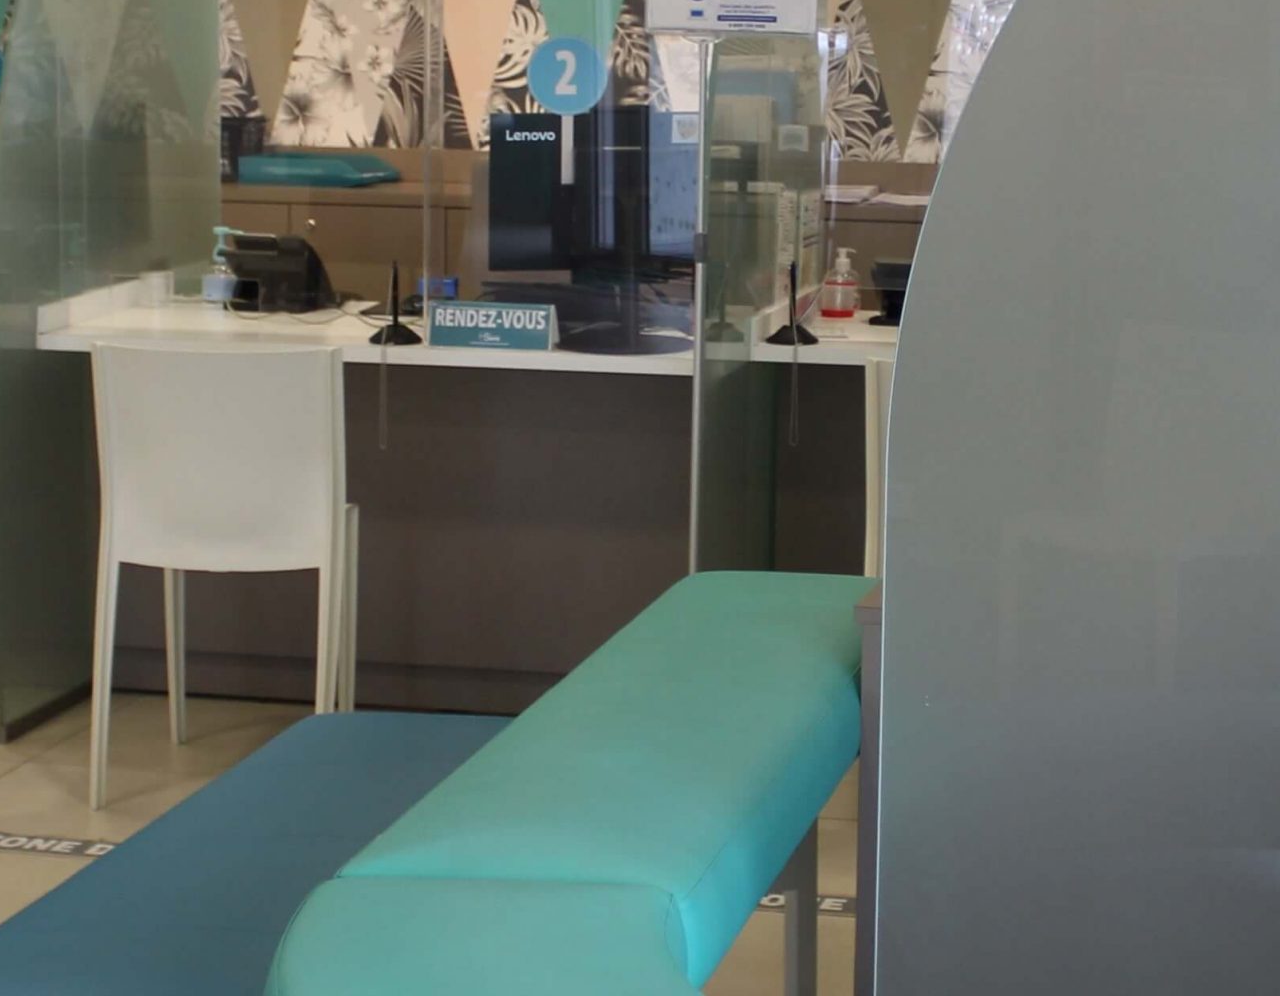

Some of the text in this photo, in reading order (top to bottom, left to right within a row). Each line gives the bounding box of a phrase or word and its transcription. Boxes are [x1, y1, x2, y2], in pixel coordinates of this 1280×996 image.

[554, 49, 578, 95] 2
[505, 129, 556, 141] Lenovo
[435, 307, 548, 330] RENDEZ-VOUS
[84, 843, 115, 855] D
